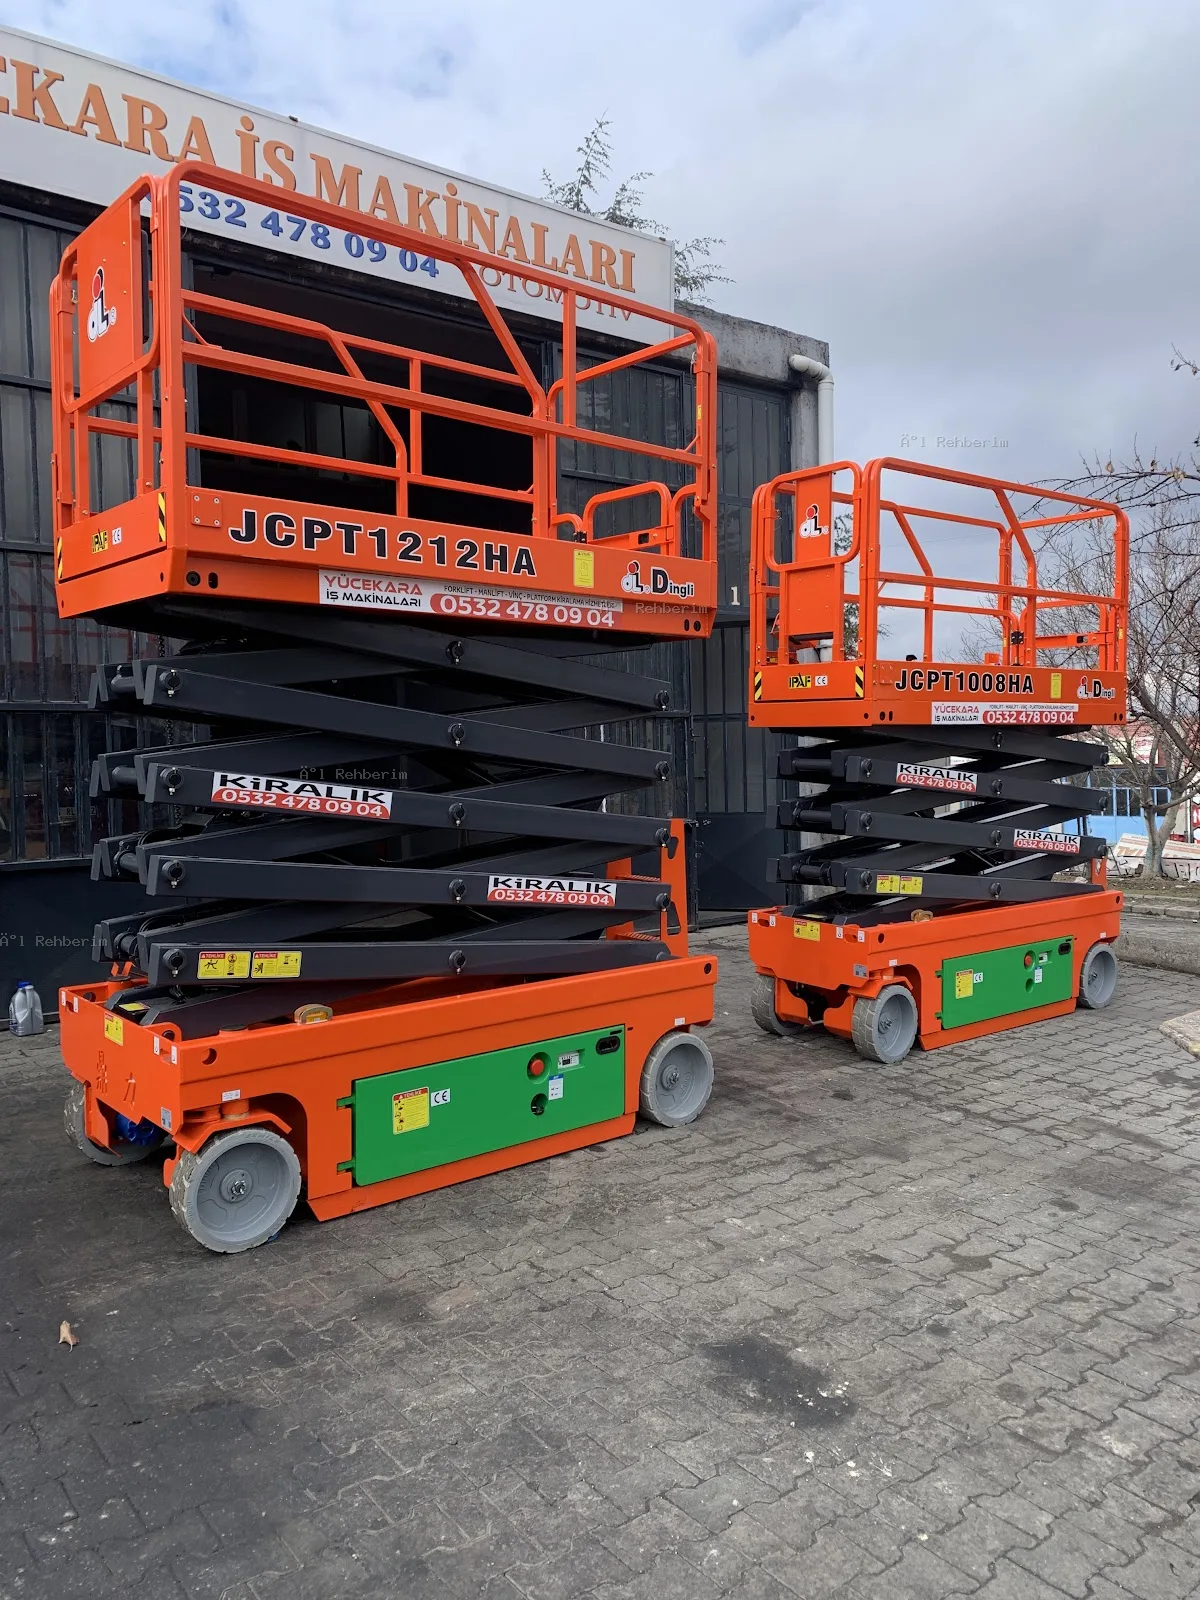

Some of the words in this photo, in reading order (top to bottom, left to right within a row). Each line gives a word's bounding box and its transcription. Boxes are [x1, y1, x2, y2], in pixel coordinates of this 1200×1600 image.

[0, 55, 216, 166] KARA
[309, 152, 636, 293] MAKİNALARI
[142, 184, 247, 228] 532
[260, 210, 331, 250] 478
[344, 232, 387, 263] 09
[398, 248, 439, 278] 04
[228, 508, 538, 578] JCPT1212HA
[323, 573, 423, 596] YÜCEKARA
[651, 567, 695, 598] Dingli
[341, 590, 421, 608] MAKİNALARI
[730, 586, 741, 606] 1
[439, 595, 501, 617] 0532
[505, 600, 549, 621] 478
[553, 605, 582, 625] 09
[587, 608, 615, 627] 04
[895, 668, 1034, 695] JCPT1008HA
[934, 703, 979, 714] YÜCEKARA
[987, 711, 1017, 724] 0532
[1019, 711, 1040, 724] 478
[1042, 711, 1058, 724] 09
[1059, 711, 1075, 724] 04
[901, 775, 925, 785] 0532
[926, 778, 944, 787] 478
[946, 780, 958, 789] 09
[960, 782, 973, 791] 04
[221, 789, 276, 806] 0532
[281, 794, 321, 810] 478
[325, 799, 351, 814] 09
[356, 803, 383, 817] 04
[1017, 839, 1038, 848] 0532
[1038, 841, 1053, 850] 478
[1054, 843, 1065, 851] 09
[1066, 844, 1076, 852] 04
[494, 889, 533, 901] 0532
[536, 891, 565, 903] 478
[568, 893, 587, 904] 09
[590, 895, 610, 905] 04
